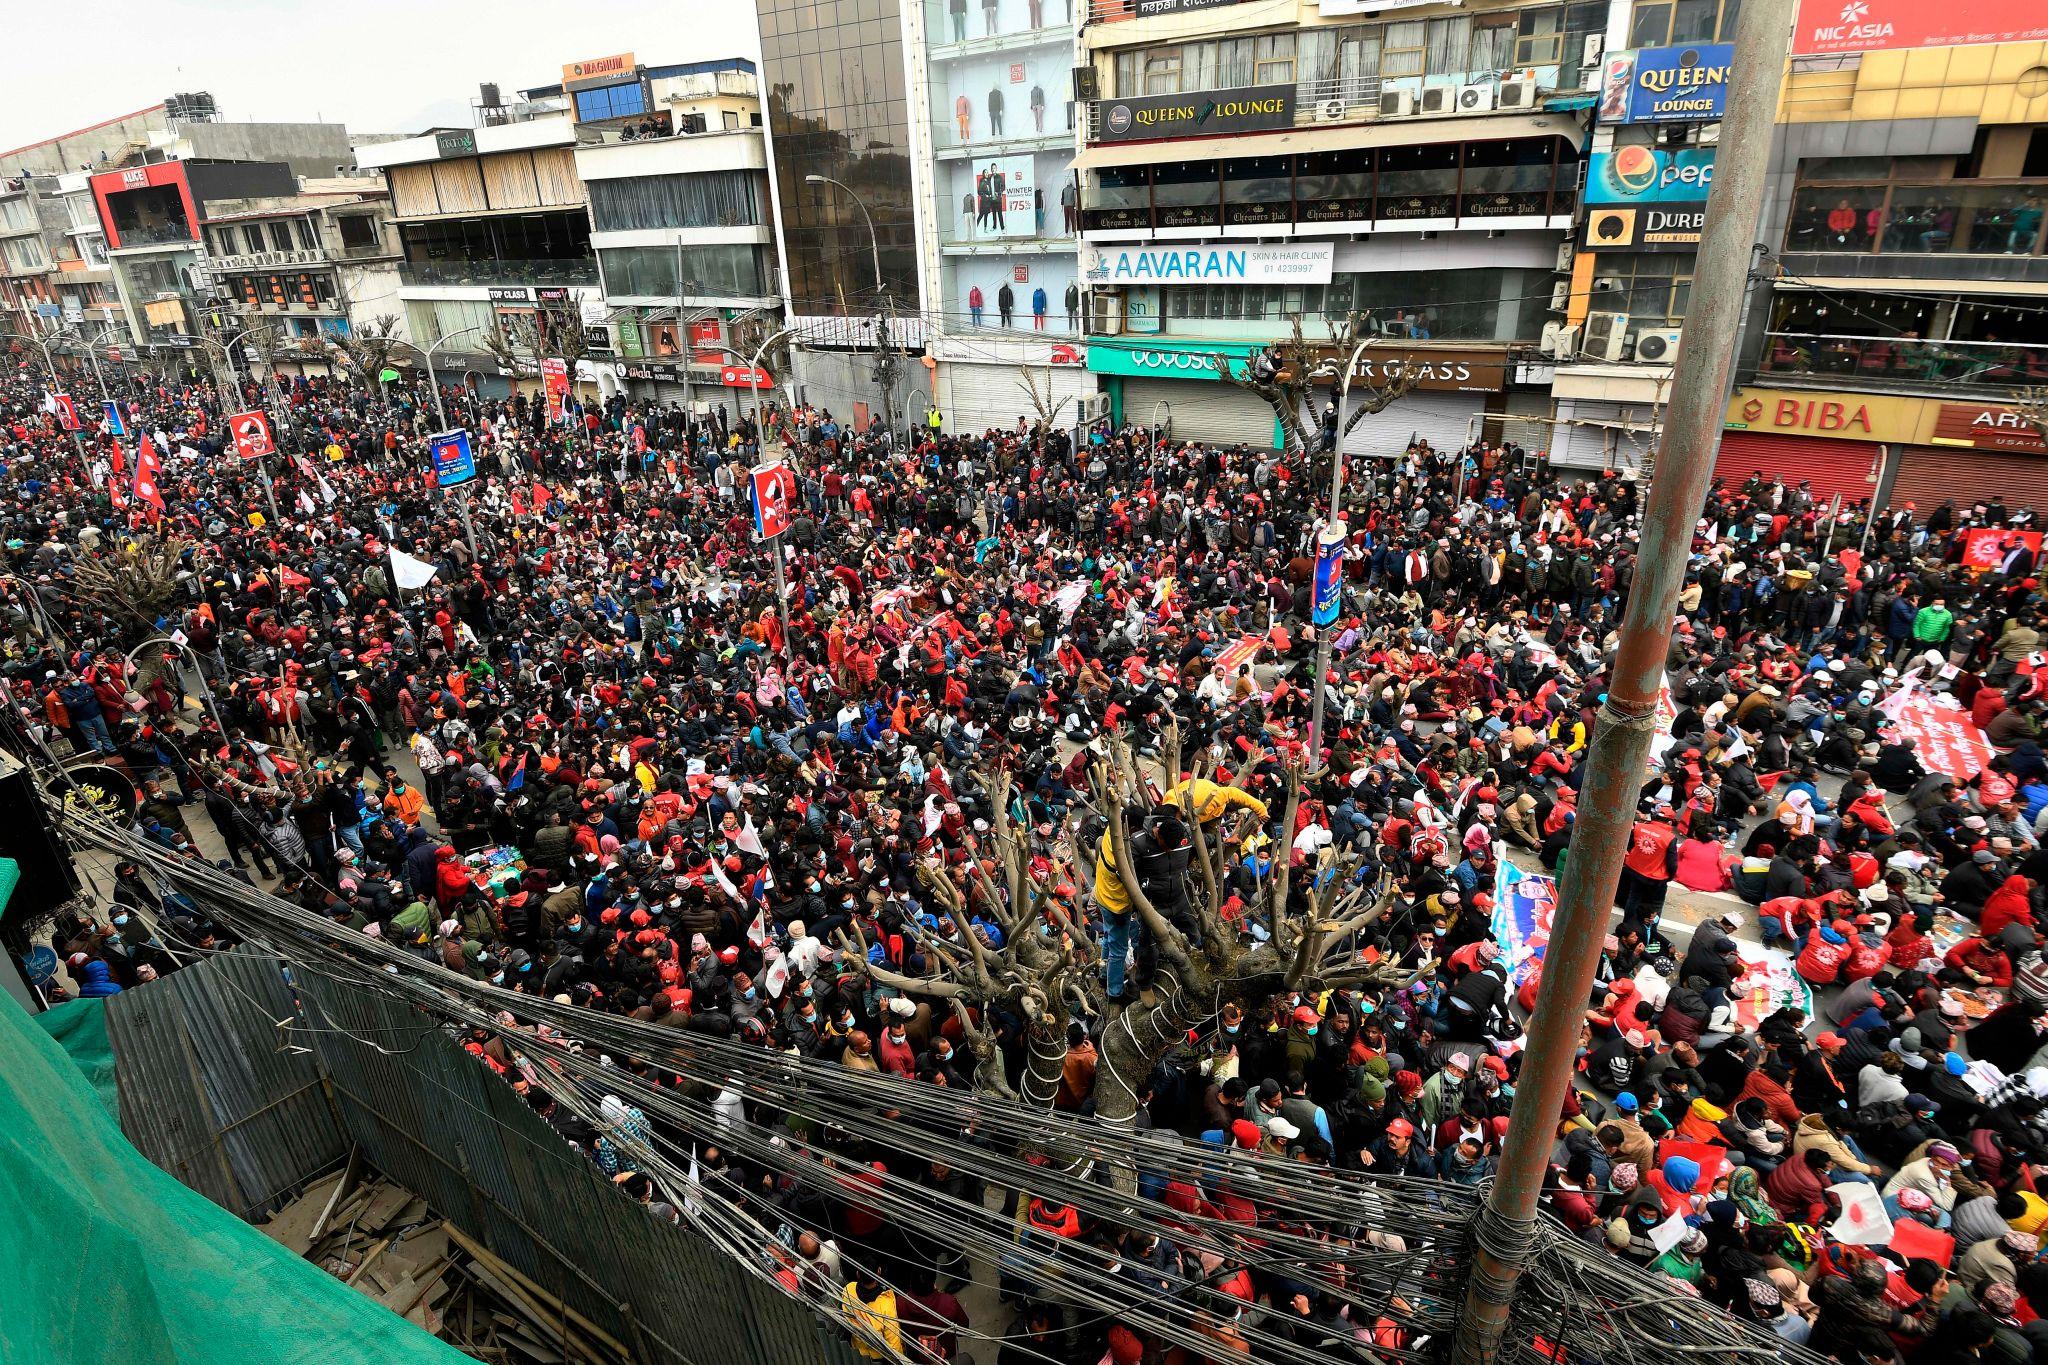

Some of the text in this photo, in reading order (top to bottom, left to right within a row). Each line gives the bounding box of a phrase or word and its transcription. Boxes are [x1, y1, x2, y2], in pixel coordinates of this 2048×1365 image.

[1813, 23, 1895, 41] NIC ASIA
[583, 57, 624, 75] MAGNUM
[1653, 99, 1714, 112] LOUNGE
[1136, 106, 1195, 125] QUEENS
[1216, 99, 1284, 117] LOUNGE
[123, 171, 145, 183] ALICE
[1006, 187, 1033, 195] WINTER
[1430, 207, 1446, 217] Pub
[1518, 203, 1535, 214] Pub
[1271, 212, 1286, 222] Pub
[1347, 209, 1363, 219] Pub
[1134, 217, 1147, 227] Pub
[1200, 215, 1214, 225] Pub
[1252, 252, 1270, 260] SKIN
[1271, 252, 1278, 260] &
[1279, 252, 1299, 260] HAIR
[1115, 250, 1246, 278] AAVARAN
[1264, 265, 1313, 273] 01 4239997
[489, 290, 526, 299] TOP CLASS
[1774, 398, 1872, 433] BIBA
